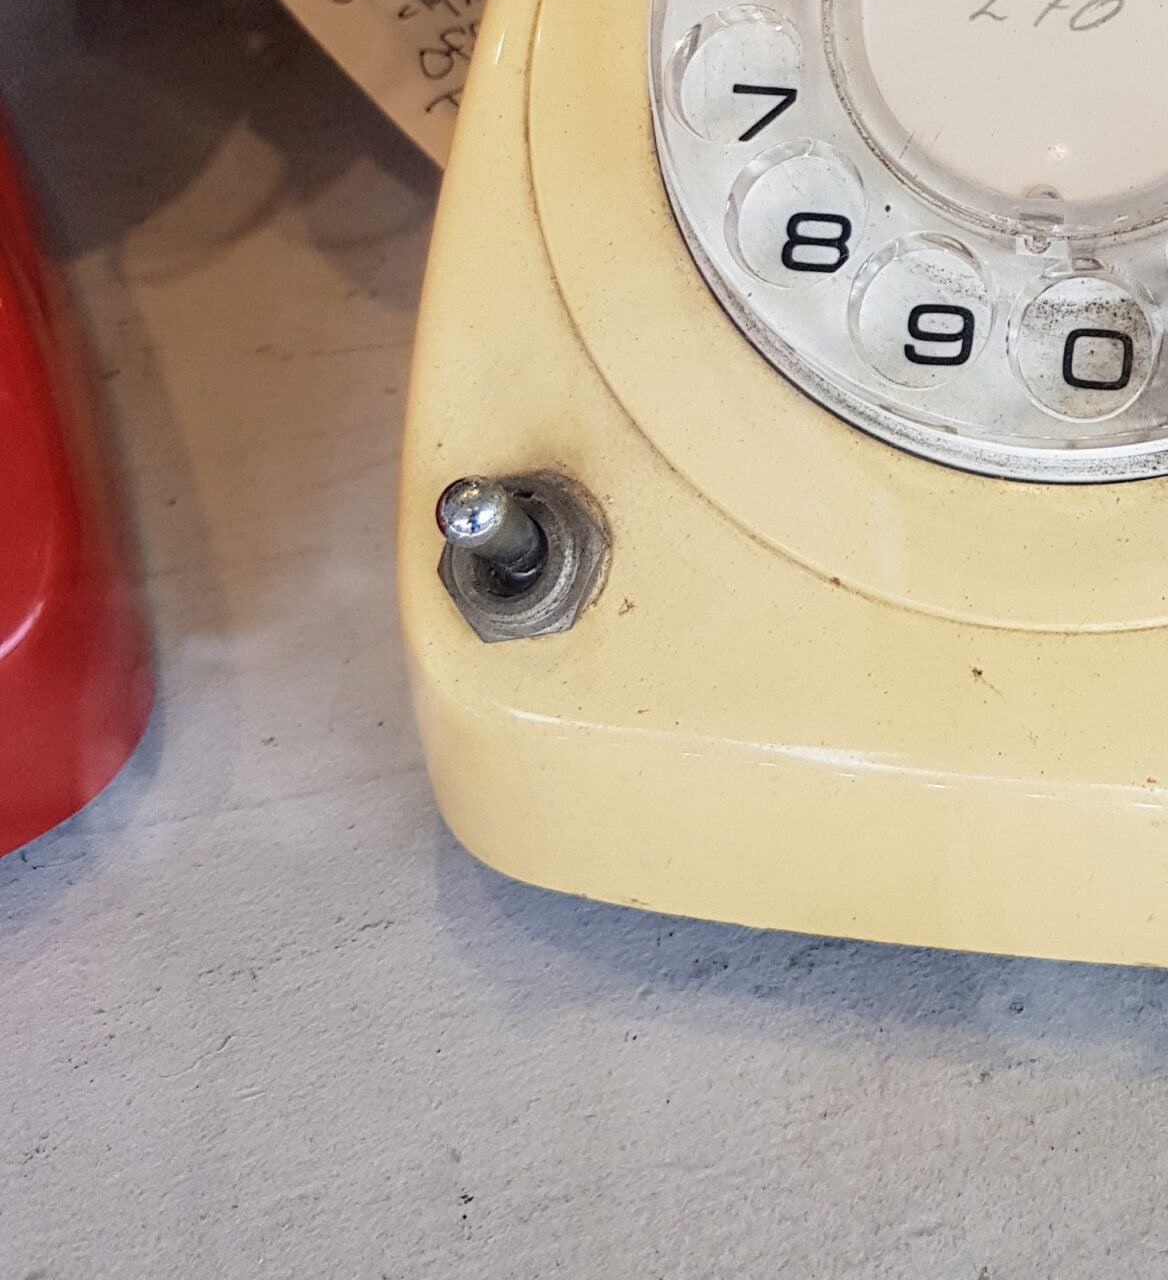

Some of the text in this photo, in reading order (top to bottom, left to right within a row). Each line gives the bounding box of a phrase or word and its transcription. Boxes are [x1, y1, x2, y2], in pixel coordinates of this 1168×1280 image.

[732, 83, 798, 142] 7
[781, 212, 852, 274] 8
[903, 304, 975, 366] 9
[1062, 328, 1134, 391] 0
